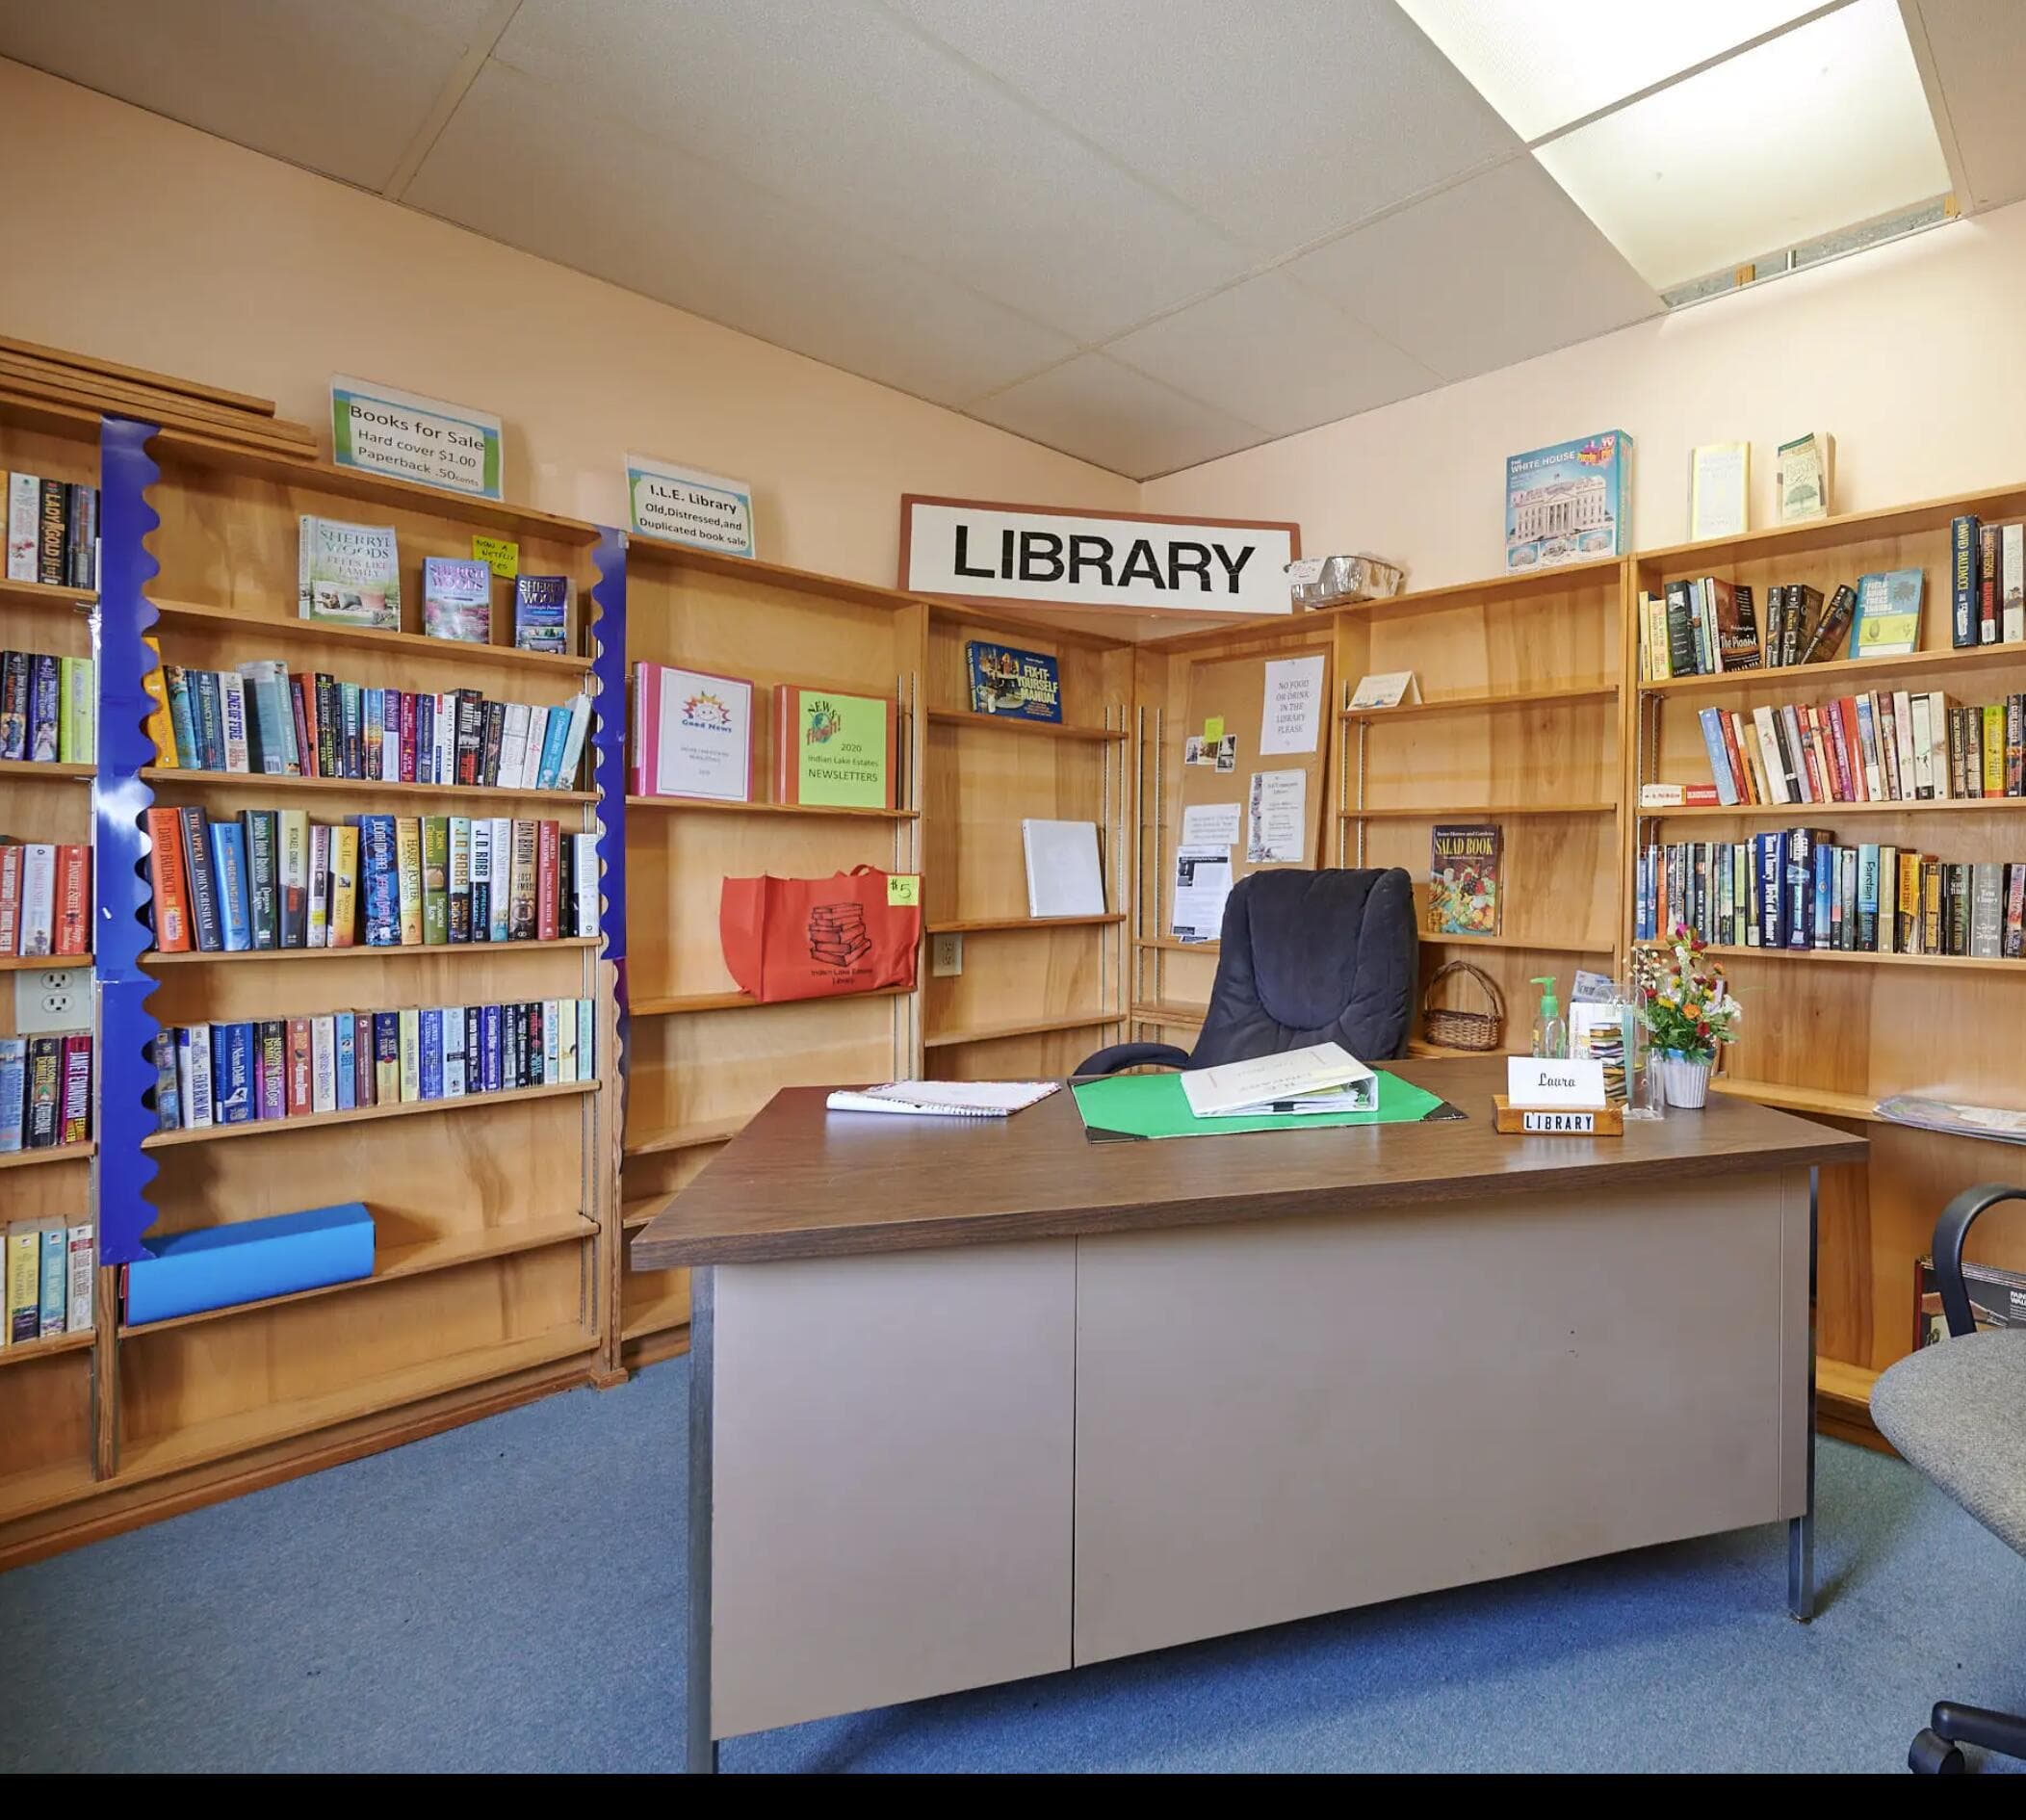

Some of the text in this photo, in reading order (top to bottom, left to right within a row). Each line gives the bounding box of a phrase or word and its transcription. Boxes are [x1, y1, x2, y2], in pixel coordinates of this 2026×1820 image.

[351, 405, 485, 452] Books for Sale
[358, 429, 476, 468] Hard cover $1.00
[358, 446, 431, 474] Paperback
[1511, 460, 1540, 473] WHITE
[1543, 451, 1575, 466] HOUSE
[650, 484, 737, 514] I.L.E. Library
[45, 493, 61, 556] LADY GOLD
[639, 518, 746, 547] Duplicated book sale
[954, 525, 1256, 593] LIBRARY
[1958, 524, 1968, 590] DAVID BALDACCI
[1017, 675, 1058, 693] YOURSELF
[1287, 691, 1310, 700] DRINK
[227, 689, 243, 740] LINE OF FIRE
[709, 723, 732, 733] News
[1277, 714, 1305, 723] LIBRARY
[834, 756, 850, 765] Lake
[852, 758, 878, 767] Estates
[841, 743, 862, 753] 2020
[808, 768, 878, 782] NEWSLETTERS
[426, 824, 434, 857] GRISHAM
[436, 830, 445, 849] JOHN
[518, 822, 533, 865] DAN BROWN
[1436, 838, 1494, 855] SALAD BOOK
[1765, 834, 1777, 852] Tom
[157, 828, 176, 894] DAVID BALDACCI
[189, 814, 213, 929] THE APPEAL JOHN GRISHAM
[407, 839, 420, 902] HARRY POTTER
[455, 853, 468, 886] ROBB
[475, 852, 488, 876] ROBB
[1765, 854, 1776, 880] Clancy
[68, 861, 82, 890] DANIELLE
[890, 878, 912, 899] $5
[1864, 861, 1876, 899] Fairstein
[452, 901, 460, 928] DEATH
[1765, 914, 1777, 940] Honor
[36, 1056, 48, 1084] DEMILLE
[46, 1056, 57, 1083] NELSON
[1538, 1072, 1576, 1087] Laura
[66, 1052, 90, 1119] JANET EVANOVICH
[1526, 1115, 1592, 1131] LIBRARY
